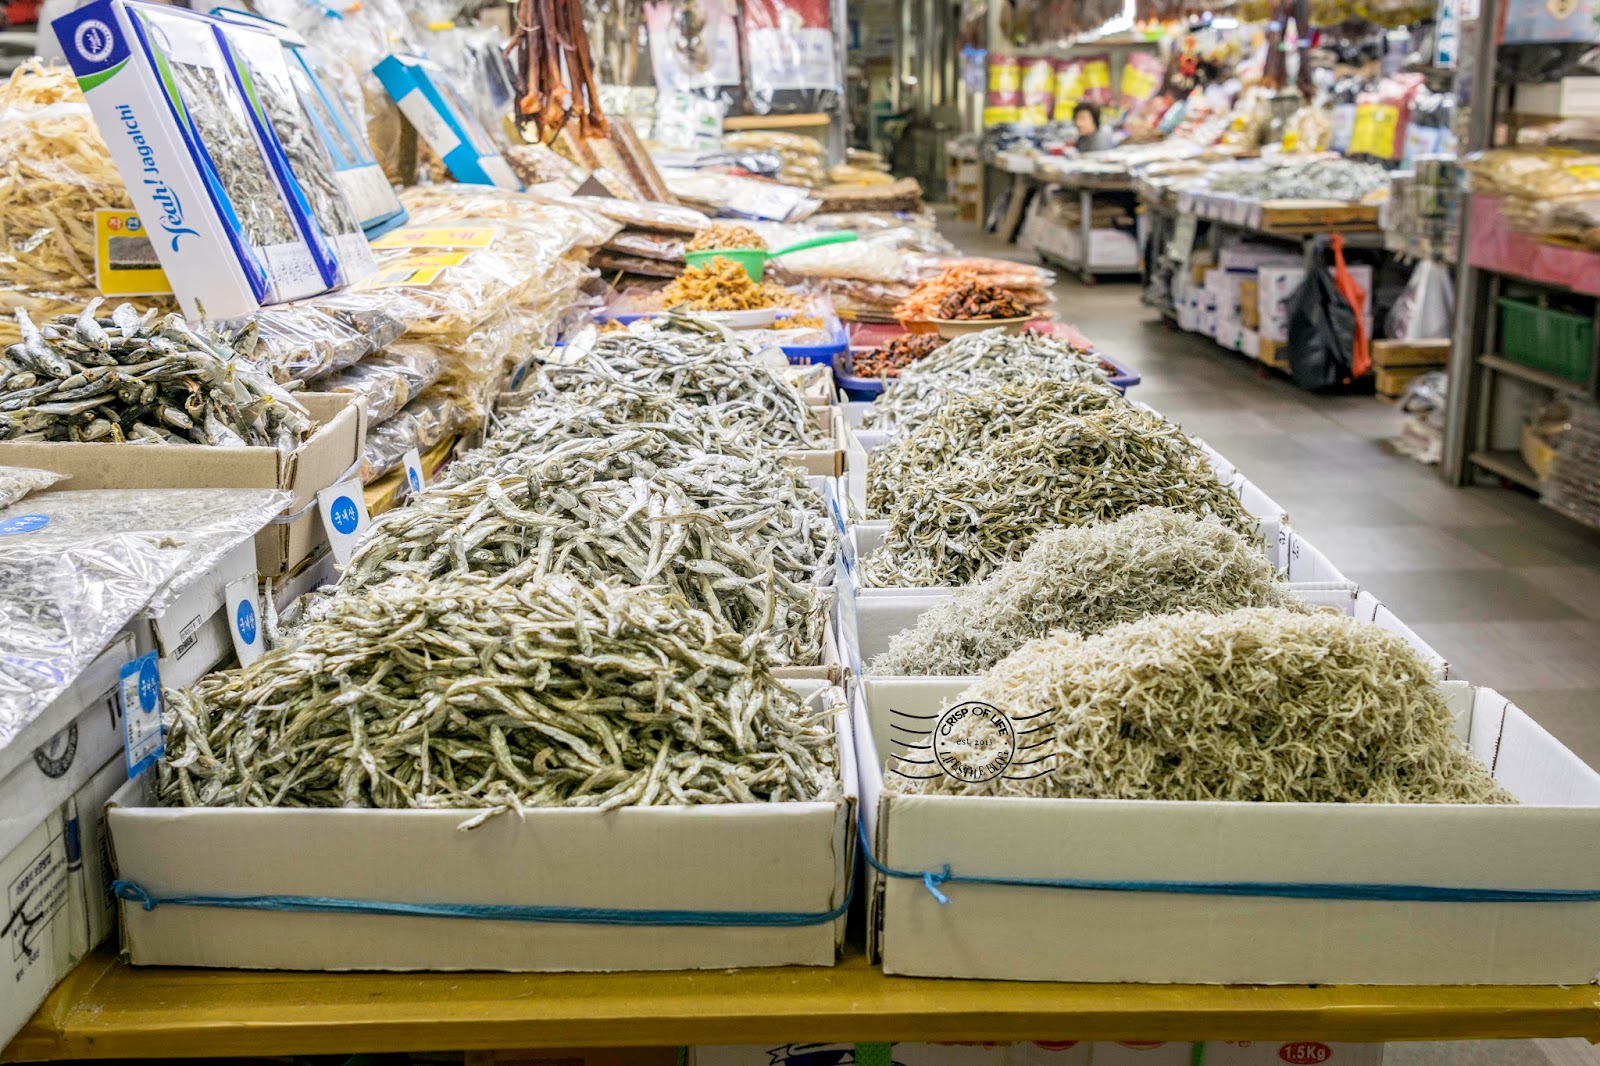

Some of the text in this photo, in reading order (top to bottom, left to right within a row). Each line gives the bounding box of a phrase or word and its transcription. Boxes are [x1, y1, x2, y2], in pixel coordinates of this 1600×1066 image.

[115, 104, 201, 252] Yeah! Jagalchi
[335, 506, 355, 525] 국내산
[1285, 1045, 1326, 1061] 1.5Kg
